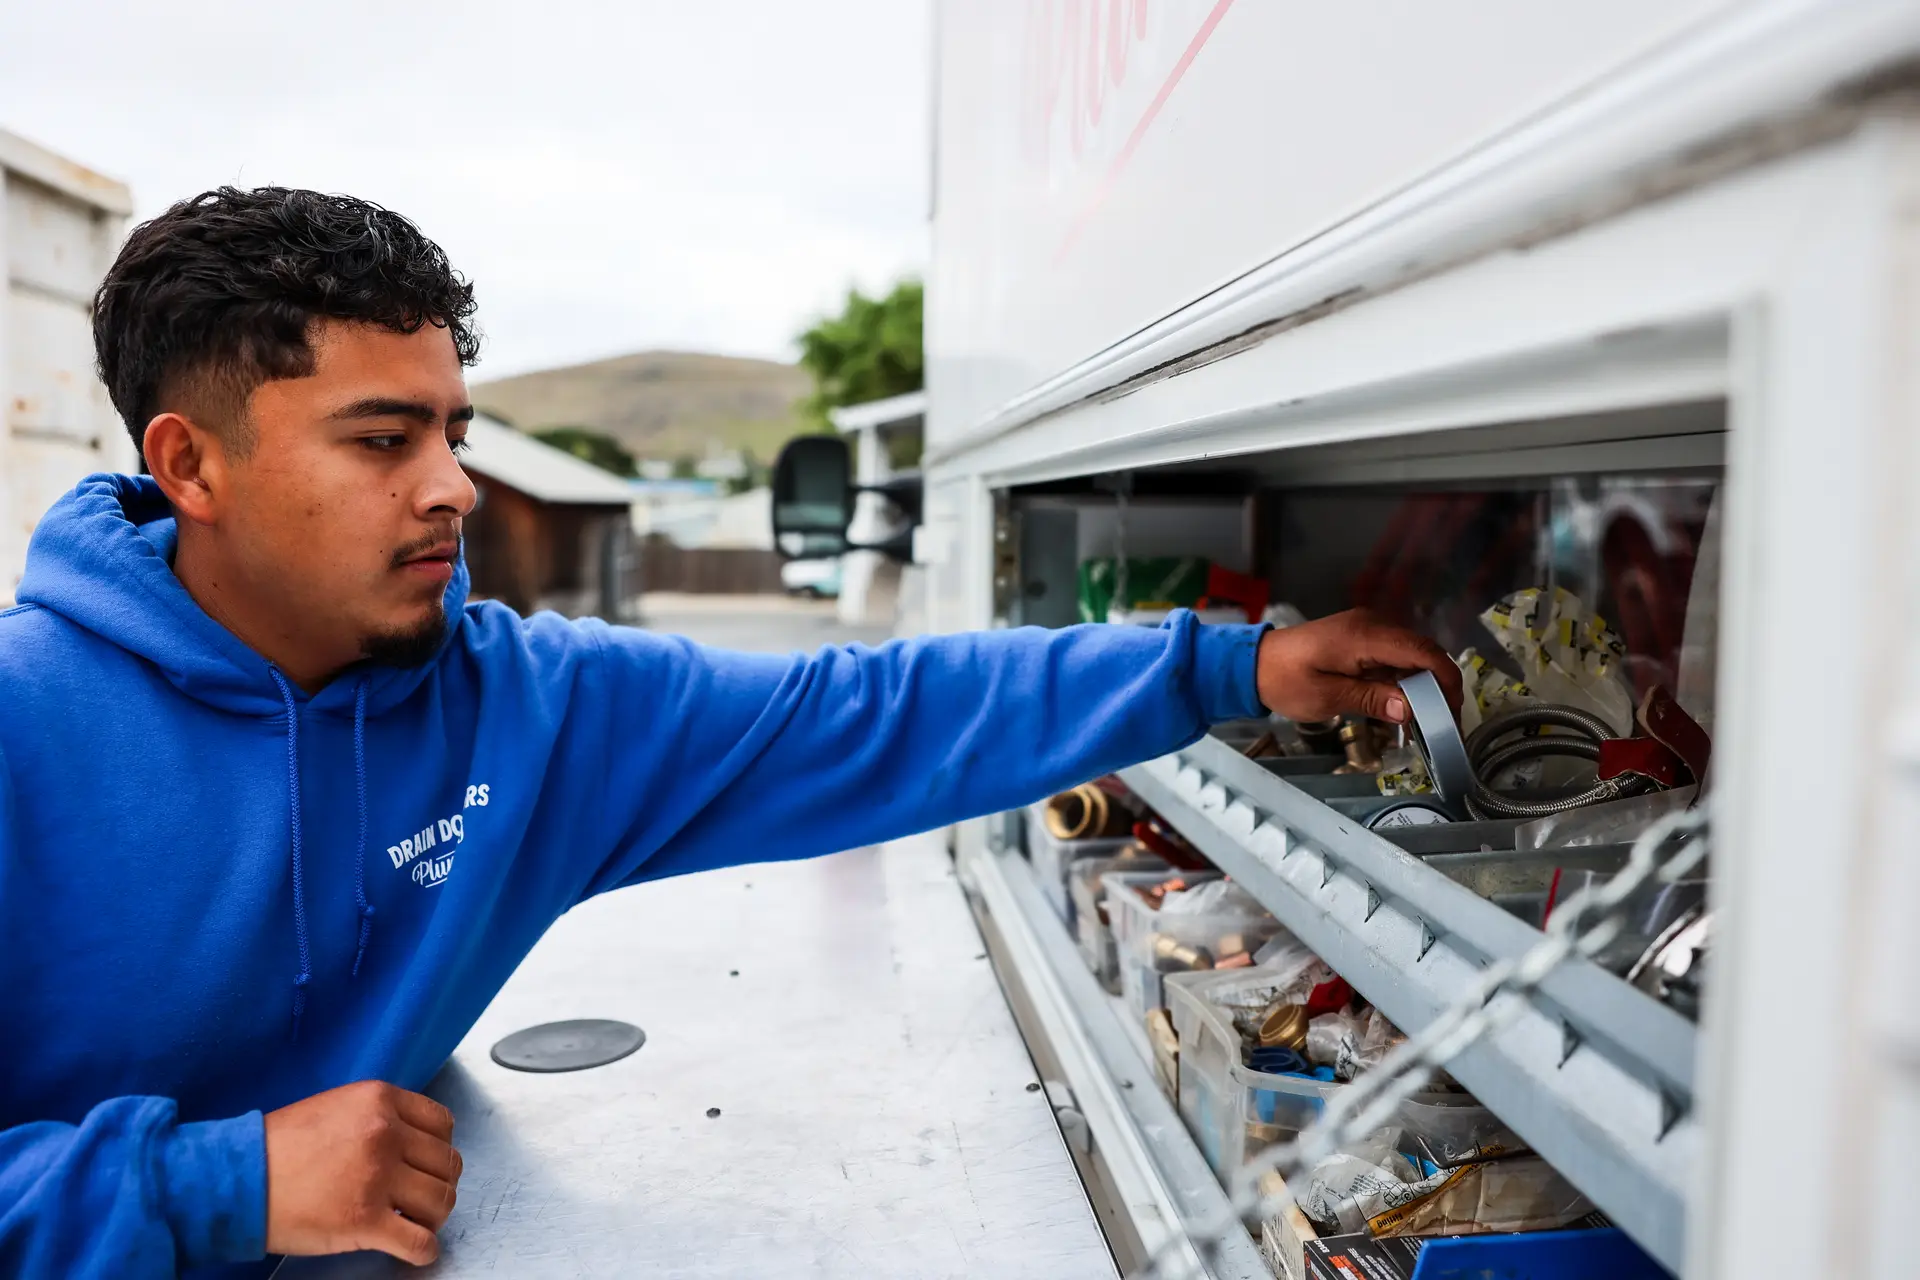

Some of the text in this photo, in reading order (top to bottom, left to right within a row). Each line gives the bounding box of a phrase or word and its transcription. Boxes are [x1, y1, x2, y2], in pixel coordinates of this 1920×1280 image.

[387, 784, 490, 869] DRAIN DORS
[1376, 1212, 1404, 1229] Fitting
